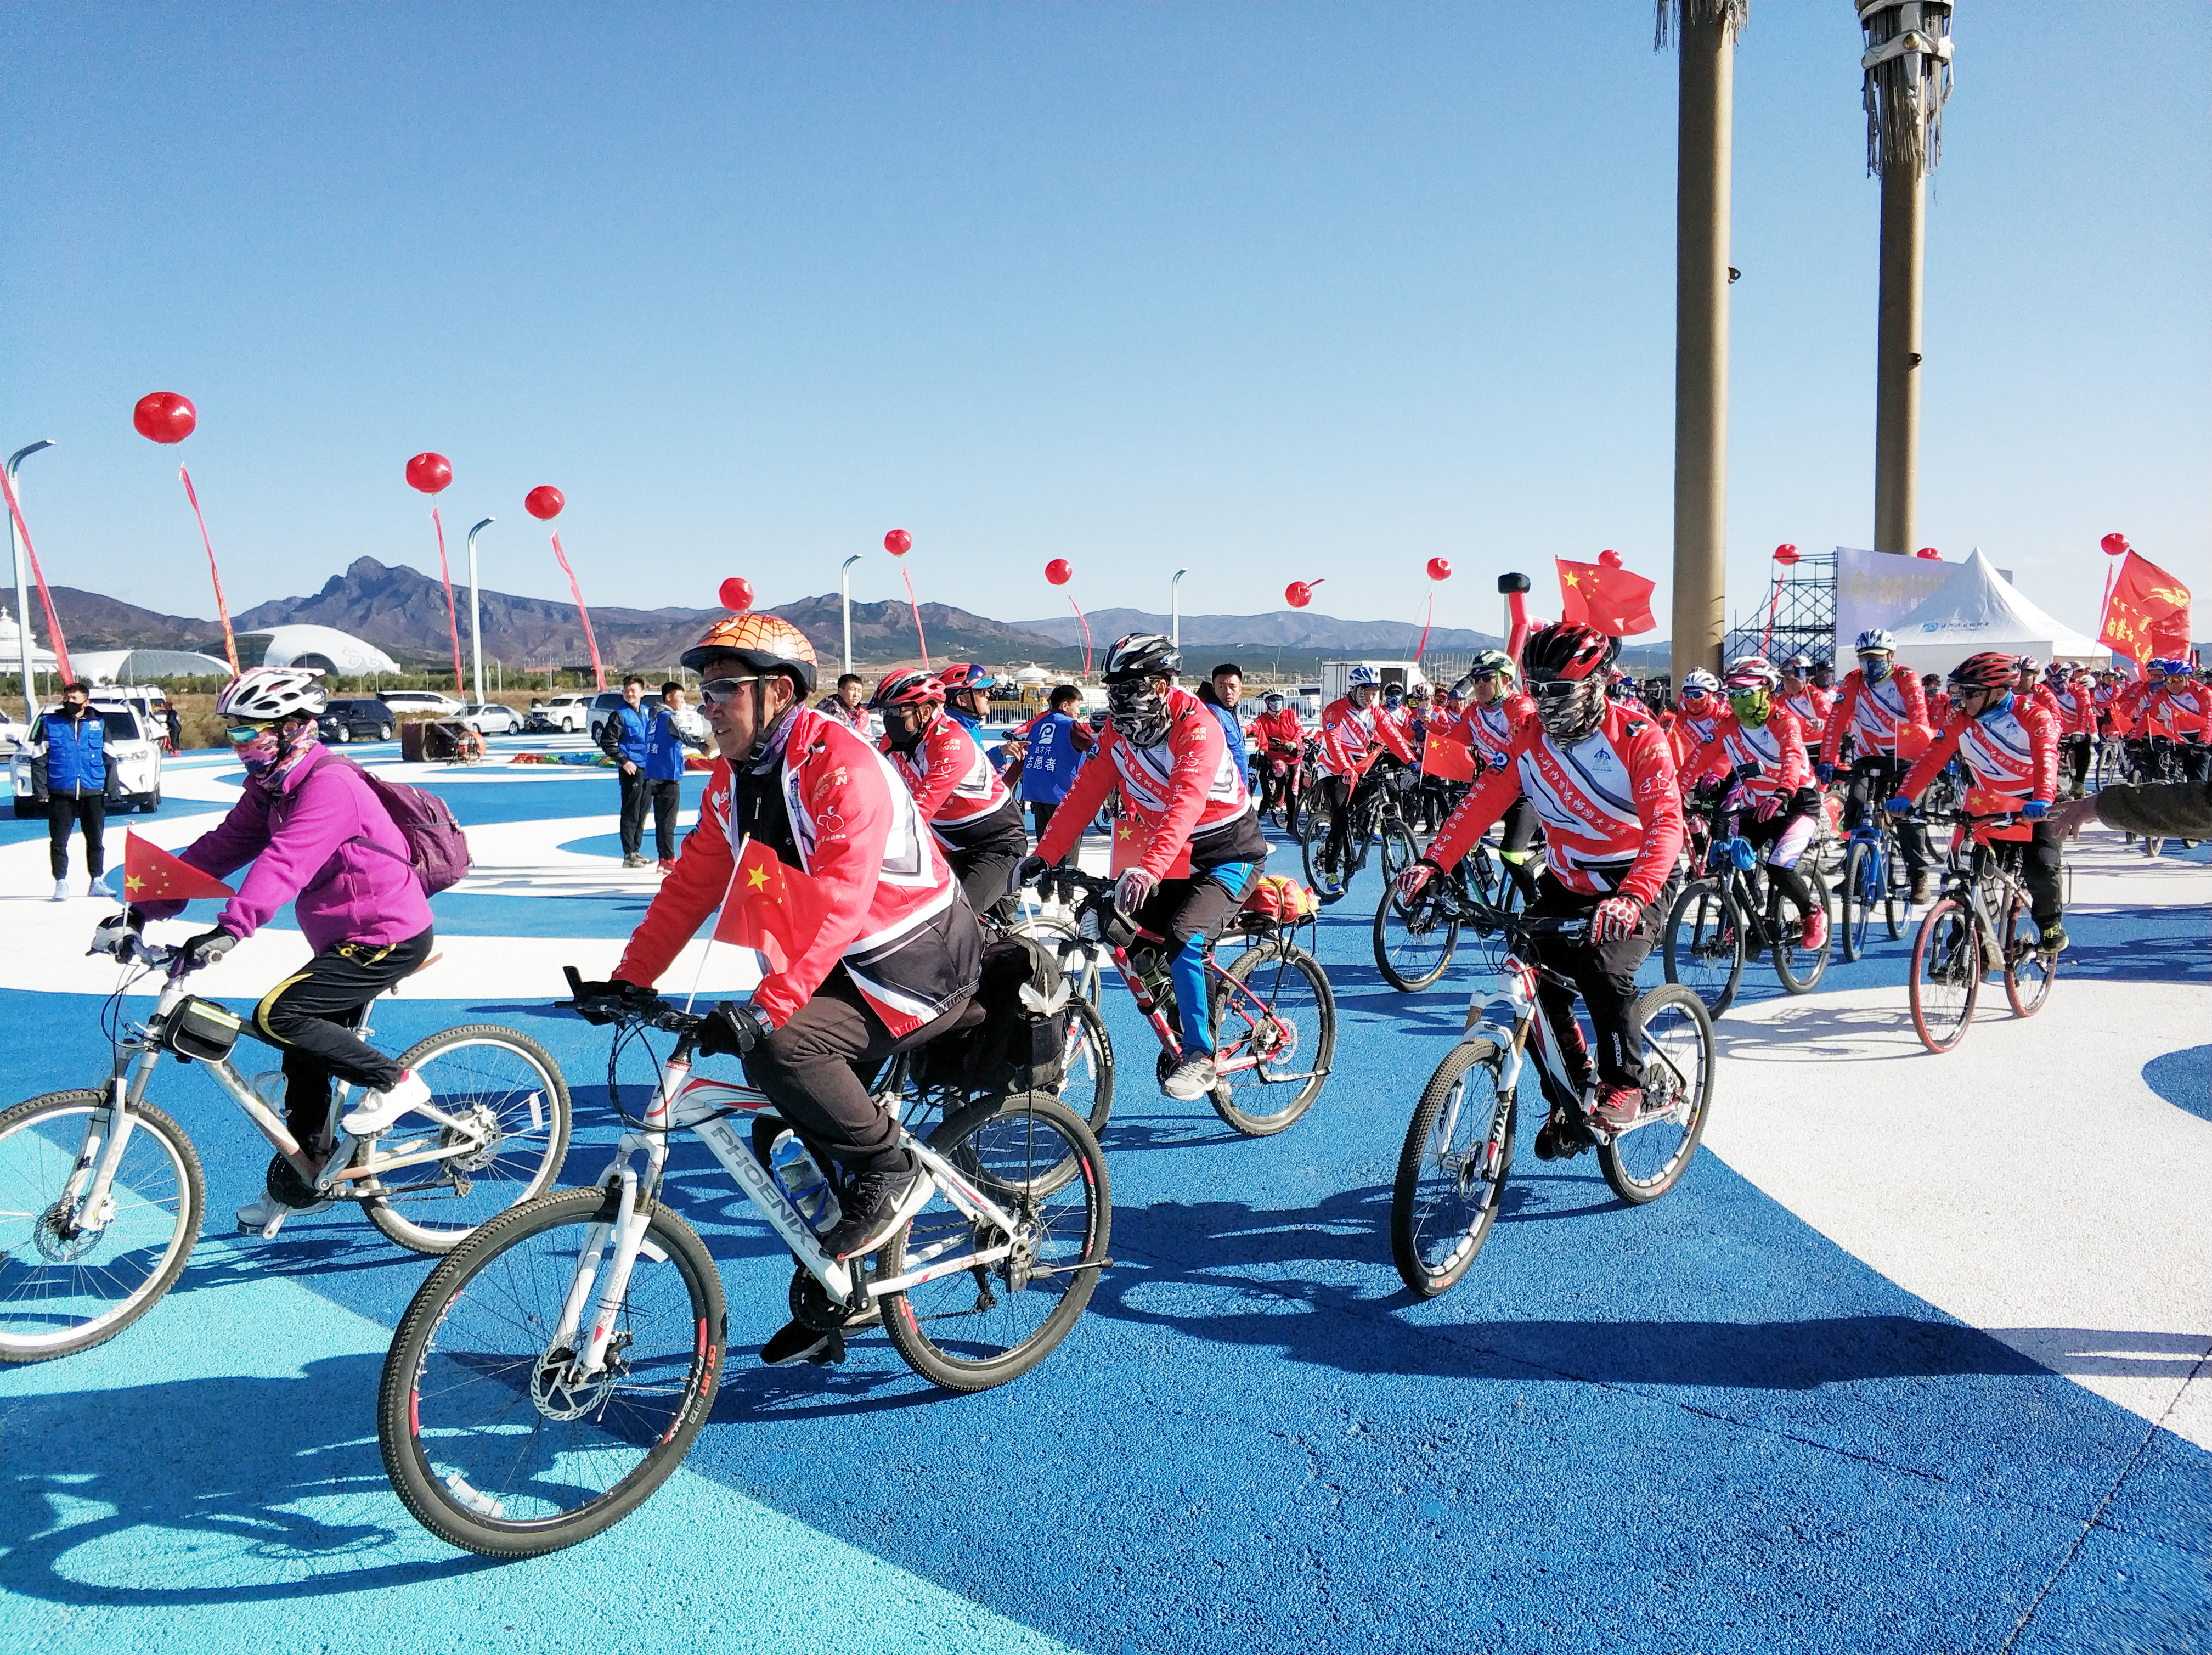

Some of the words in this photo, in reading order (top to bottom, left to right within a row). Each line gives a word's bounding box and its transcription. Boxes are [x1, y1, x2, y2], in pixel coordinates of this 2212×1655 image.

[1026, 756, 1057, 773] 志愿者
[1097, 1027, 1111, 1067] MAXXIS
[1612, 1032, 1623, 1066] ROCKBROS
[710, 1126, 813, 1247] PHOENIX
[98, 1293, 144, 1324] LARA
[699, 1371, 712, 1397] JET
